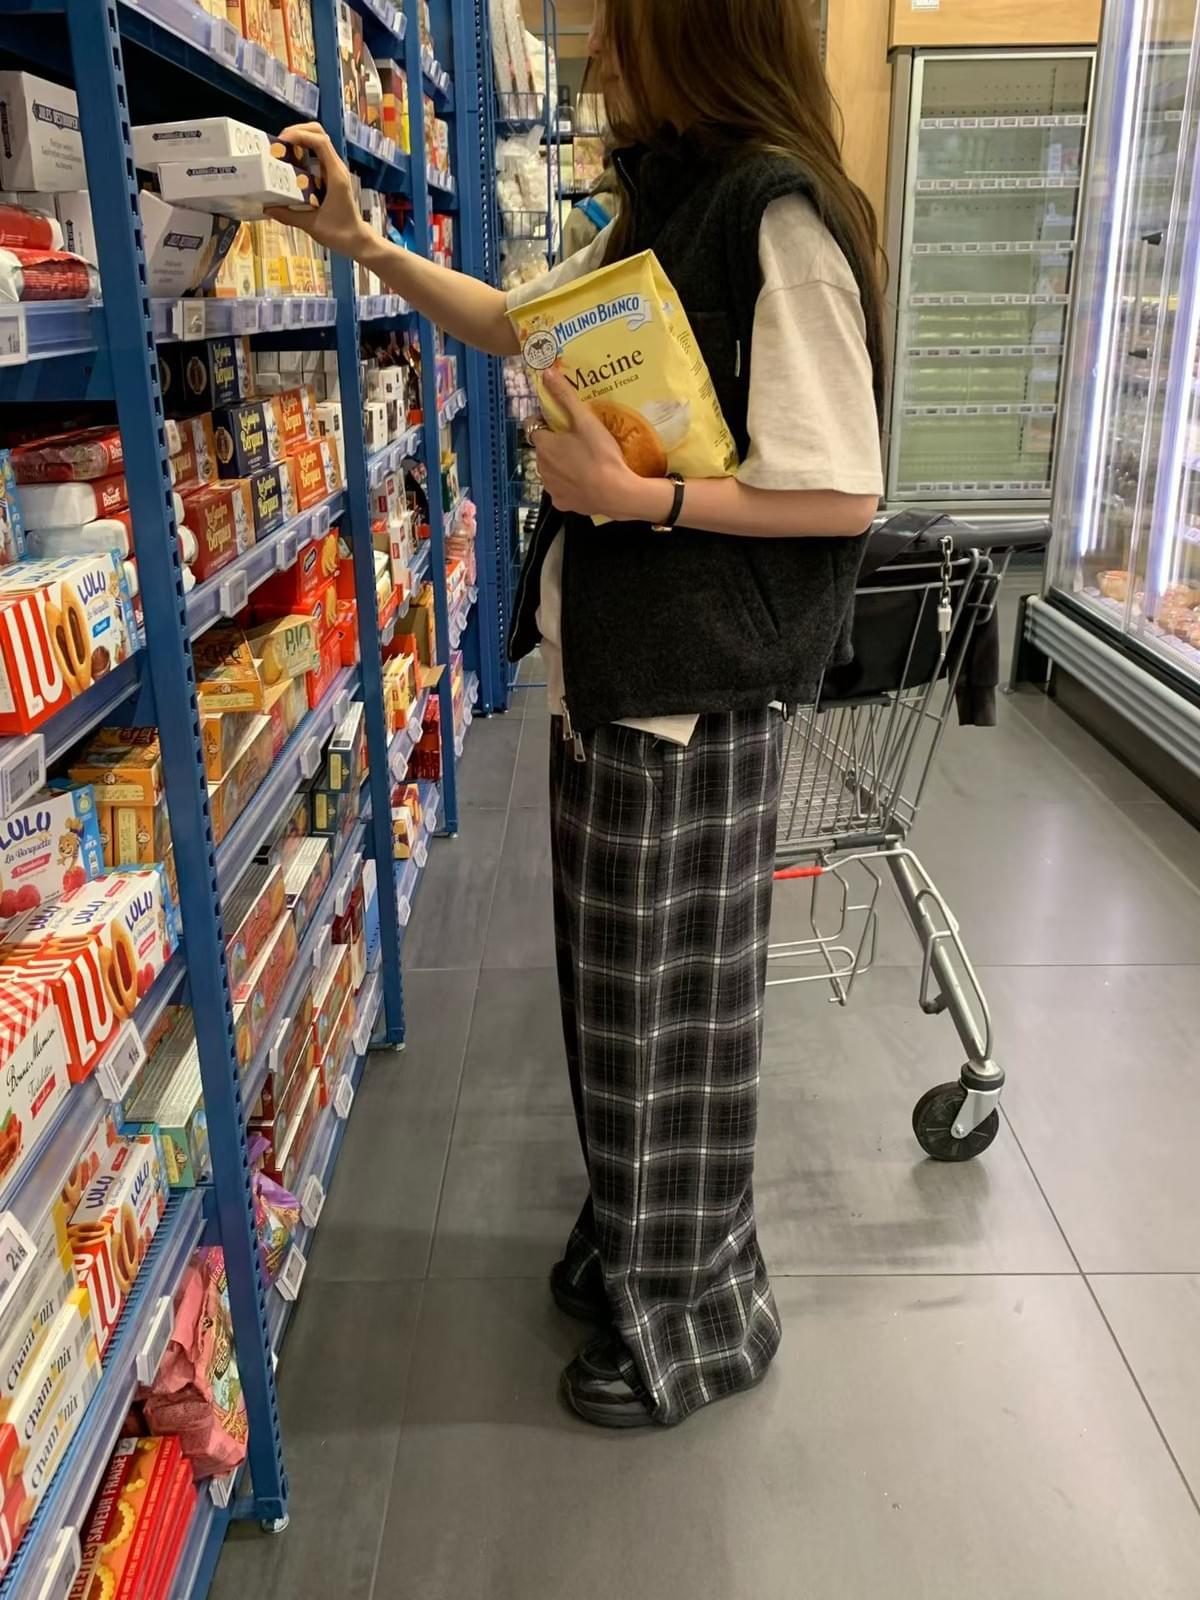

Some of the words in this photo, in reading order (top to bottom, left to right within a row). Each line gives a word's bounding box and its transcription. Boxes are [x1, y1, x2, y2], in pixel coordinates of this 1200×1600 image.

[554, 310, 598, 345] MULINO
[597, 296, 640, 323] BIANCO
[563, 349, 645, 391] Macine
[592, 384, 614, 398] Panna
[614, 374, 640, 389] Fresca
[77, 570, 106, 605] LULU
[3, 590, 63, 720] LU
[71, 900, 107, 926] LULU
[125, 890, 153, 931] LULU
[62, 944, 113, 1067] LU
[6, 1062, 34, 1098] Bonne
[85, 1175, 115, 1209] LULU
[130, 1160, 150, 1207] LULU
[86, 1494, 114, 1543] SAVEUR
[102, 1454, 128, 1497] FRAISE
